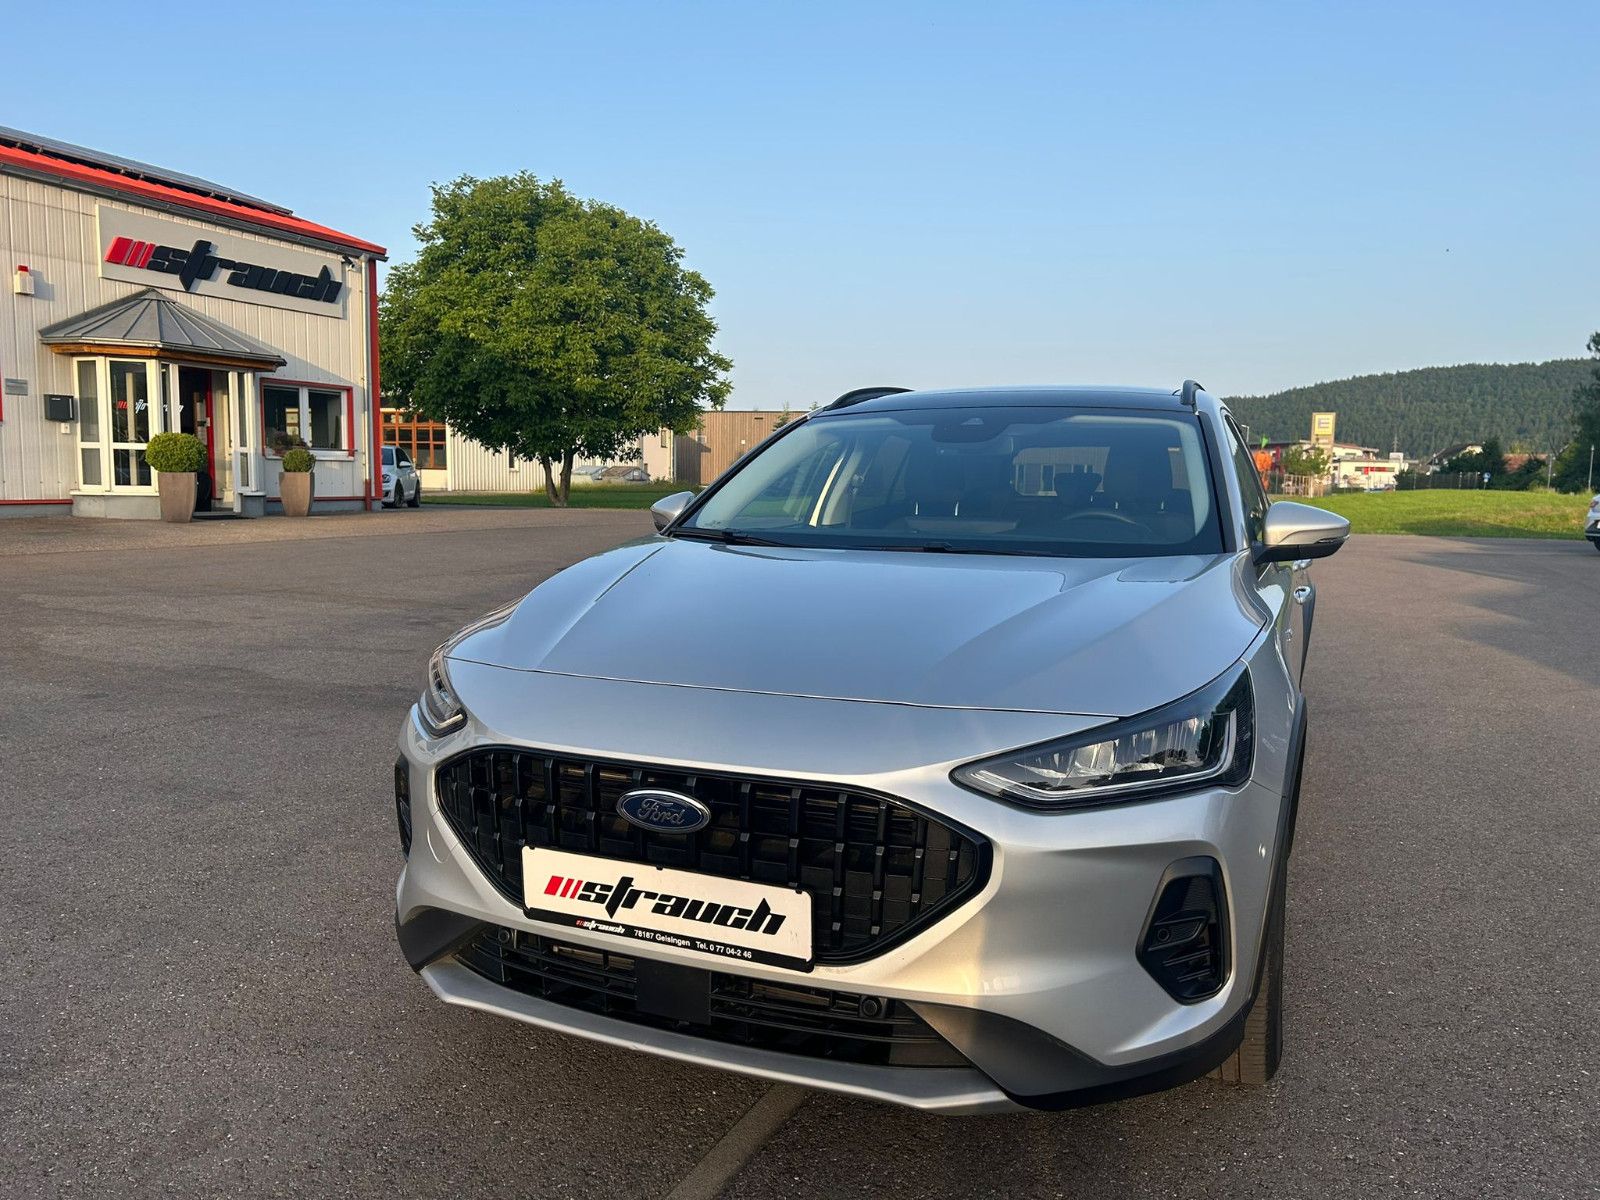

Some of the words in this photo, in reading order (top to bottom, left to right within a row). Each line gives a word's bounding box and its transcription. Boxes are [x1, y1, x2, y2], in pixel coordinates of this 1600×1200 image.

[147, 240, 343, 304] strauch
[637, 798, 686, 825] Ford
[577, 876, 787, 935] strauch
[634, 929, 654, 940] 78187
[655, 933, 691, 947] Geisingen
[696, 941, 709, 950] Tel.
[715, 945, 725, 953] 77
[726, 947, 742, 957] 04-2
[742, 951, 752, 959] 46
